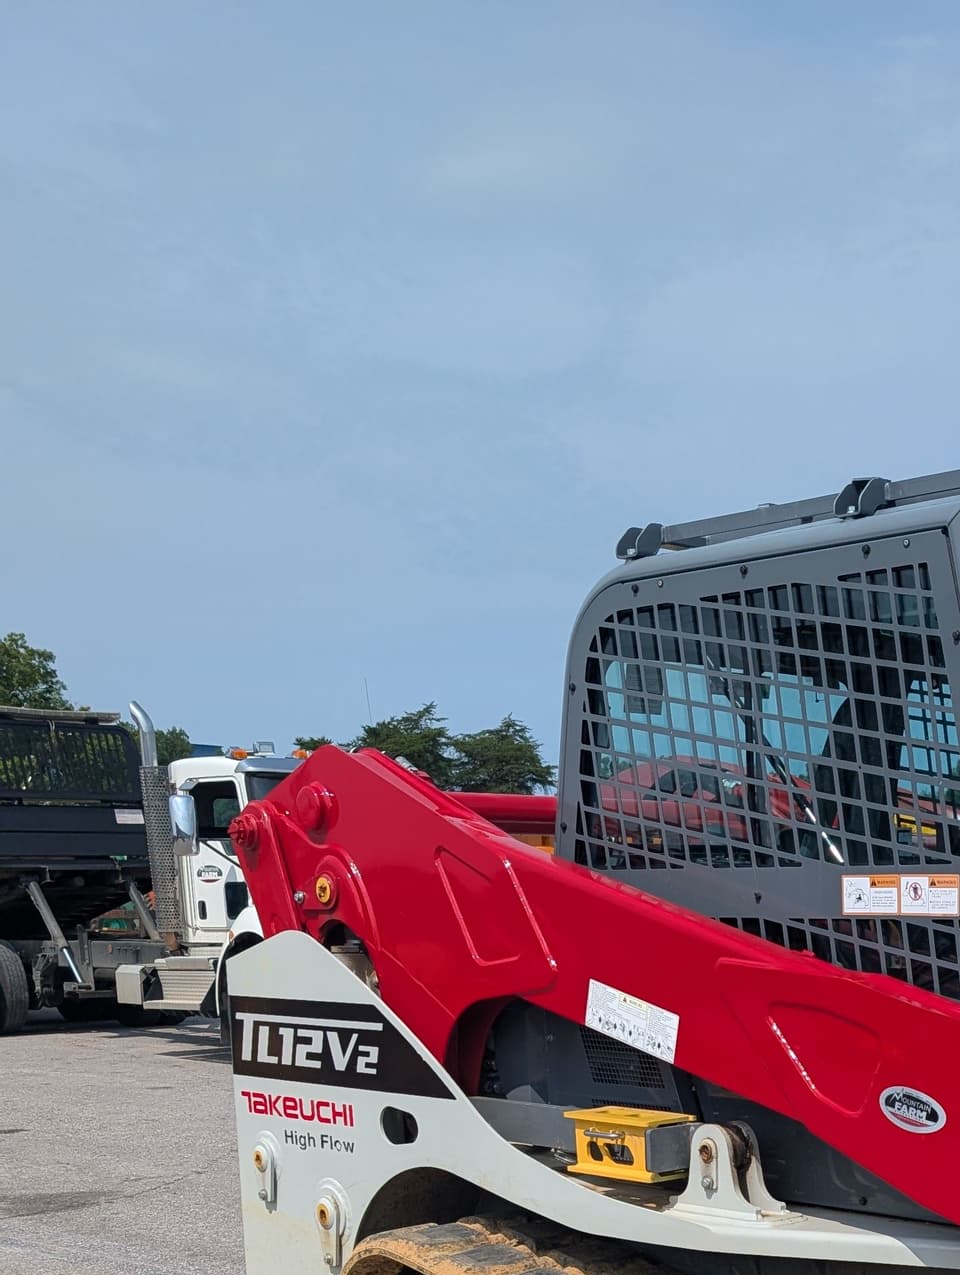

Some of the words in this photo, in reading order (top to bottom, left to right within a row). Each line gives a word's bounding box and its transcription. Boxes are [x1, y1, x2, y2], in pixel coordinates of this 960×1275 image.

[235, 1012, 384, 1075] TL12V2
[241, 1090, 355, 1127] TAKEUCHI
[889, 1088, 932, 1115] MOUNTAIN
[894, 1102, 927, 1120] FARM
[284, 1129, 316, 1150] High
[320, 1134, 355, 1153] Flow
